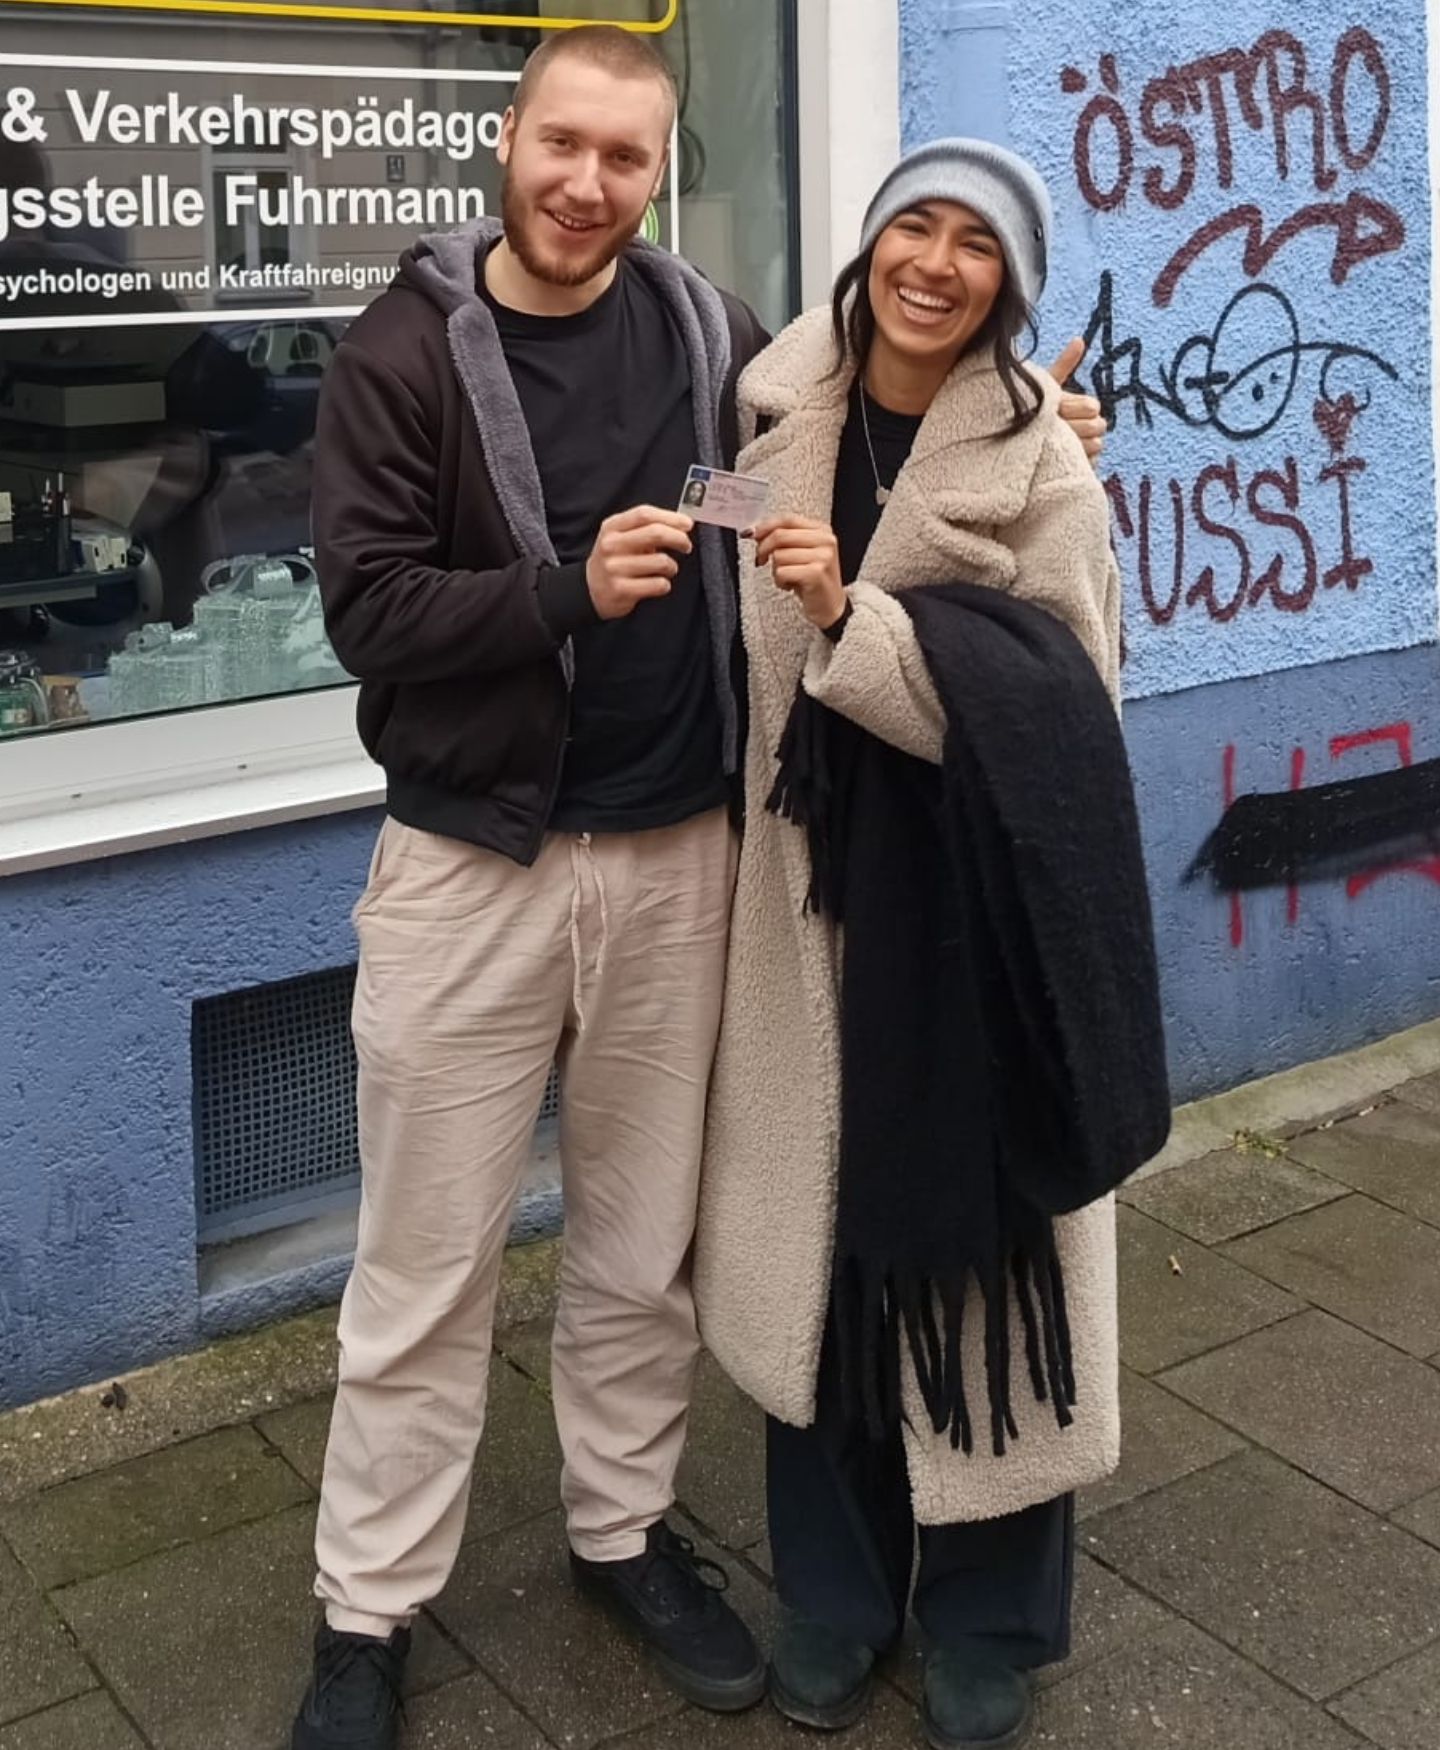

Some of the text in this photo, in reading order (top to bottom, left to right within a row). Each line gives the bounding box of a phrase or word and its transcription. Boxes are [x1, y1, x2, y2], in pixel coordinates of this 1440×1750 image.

[1, 87, 504, 160] & Verkehrspädago
[226, 175, 485, 226] Fuhrmann
[161, 264, 211, 290] und
[219, 261, 401, 291] Kraftfahreignu
